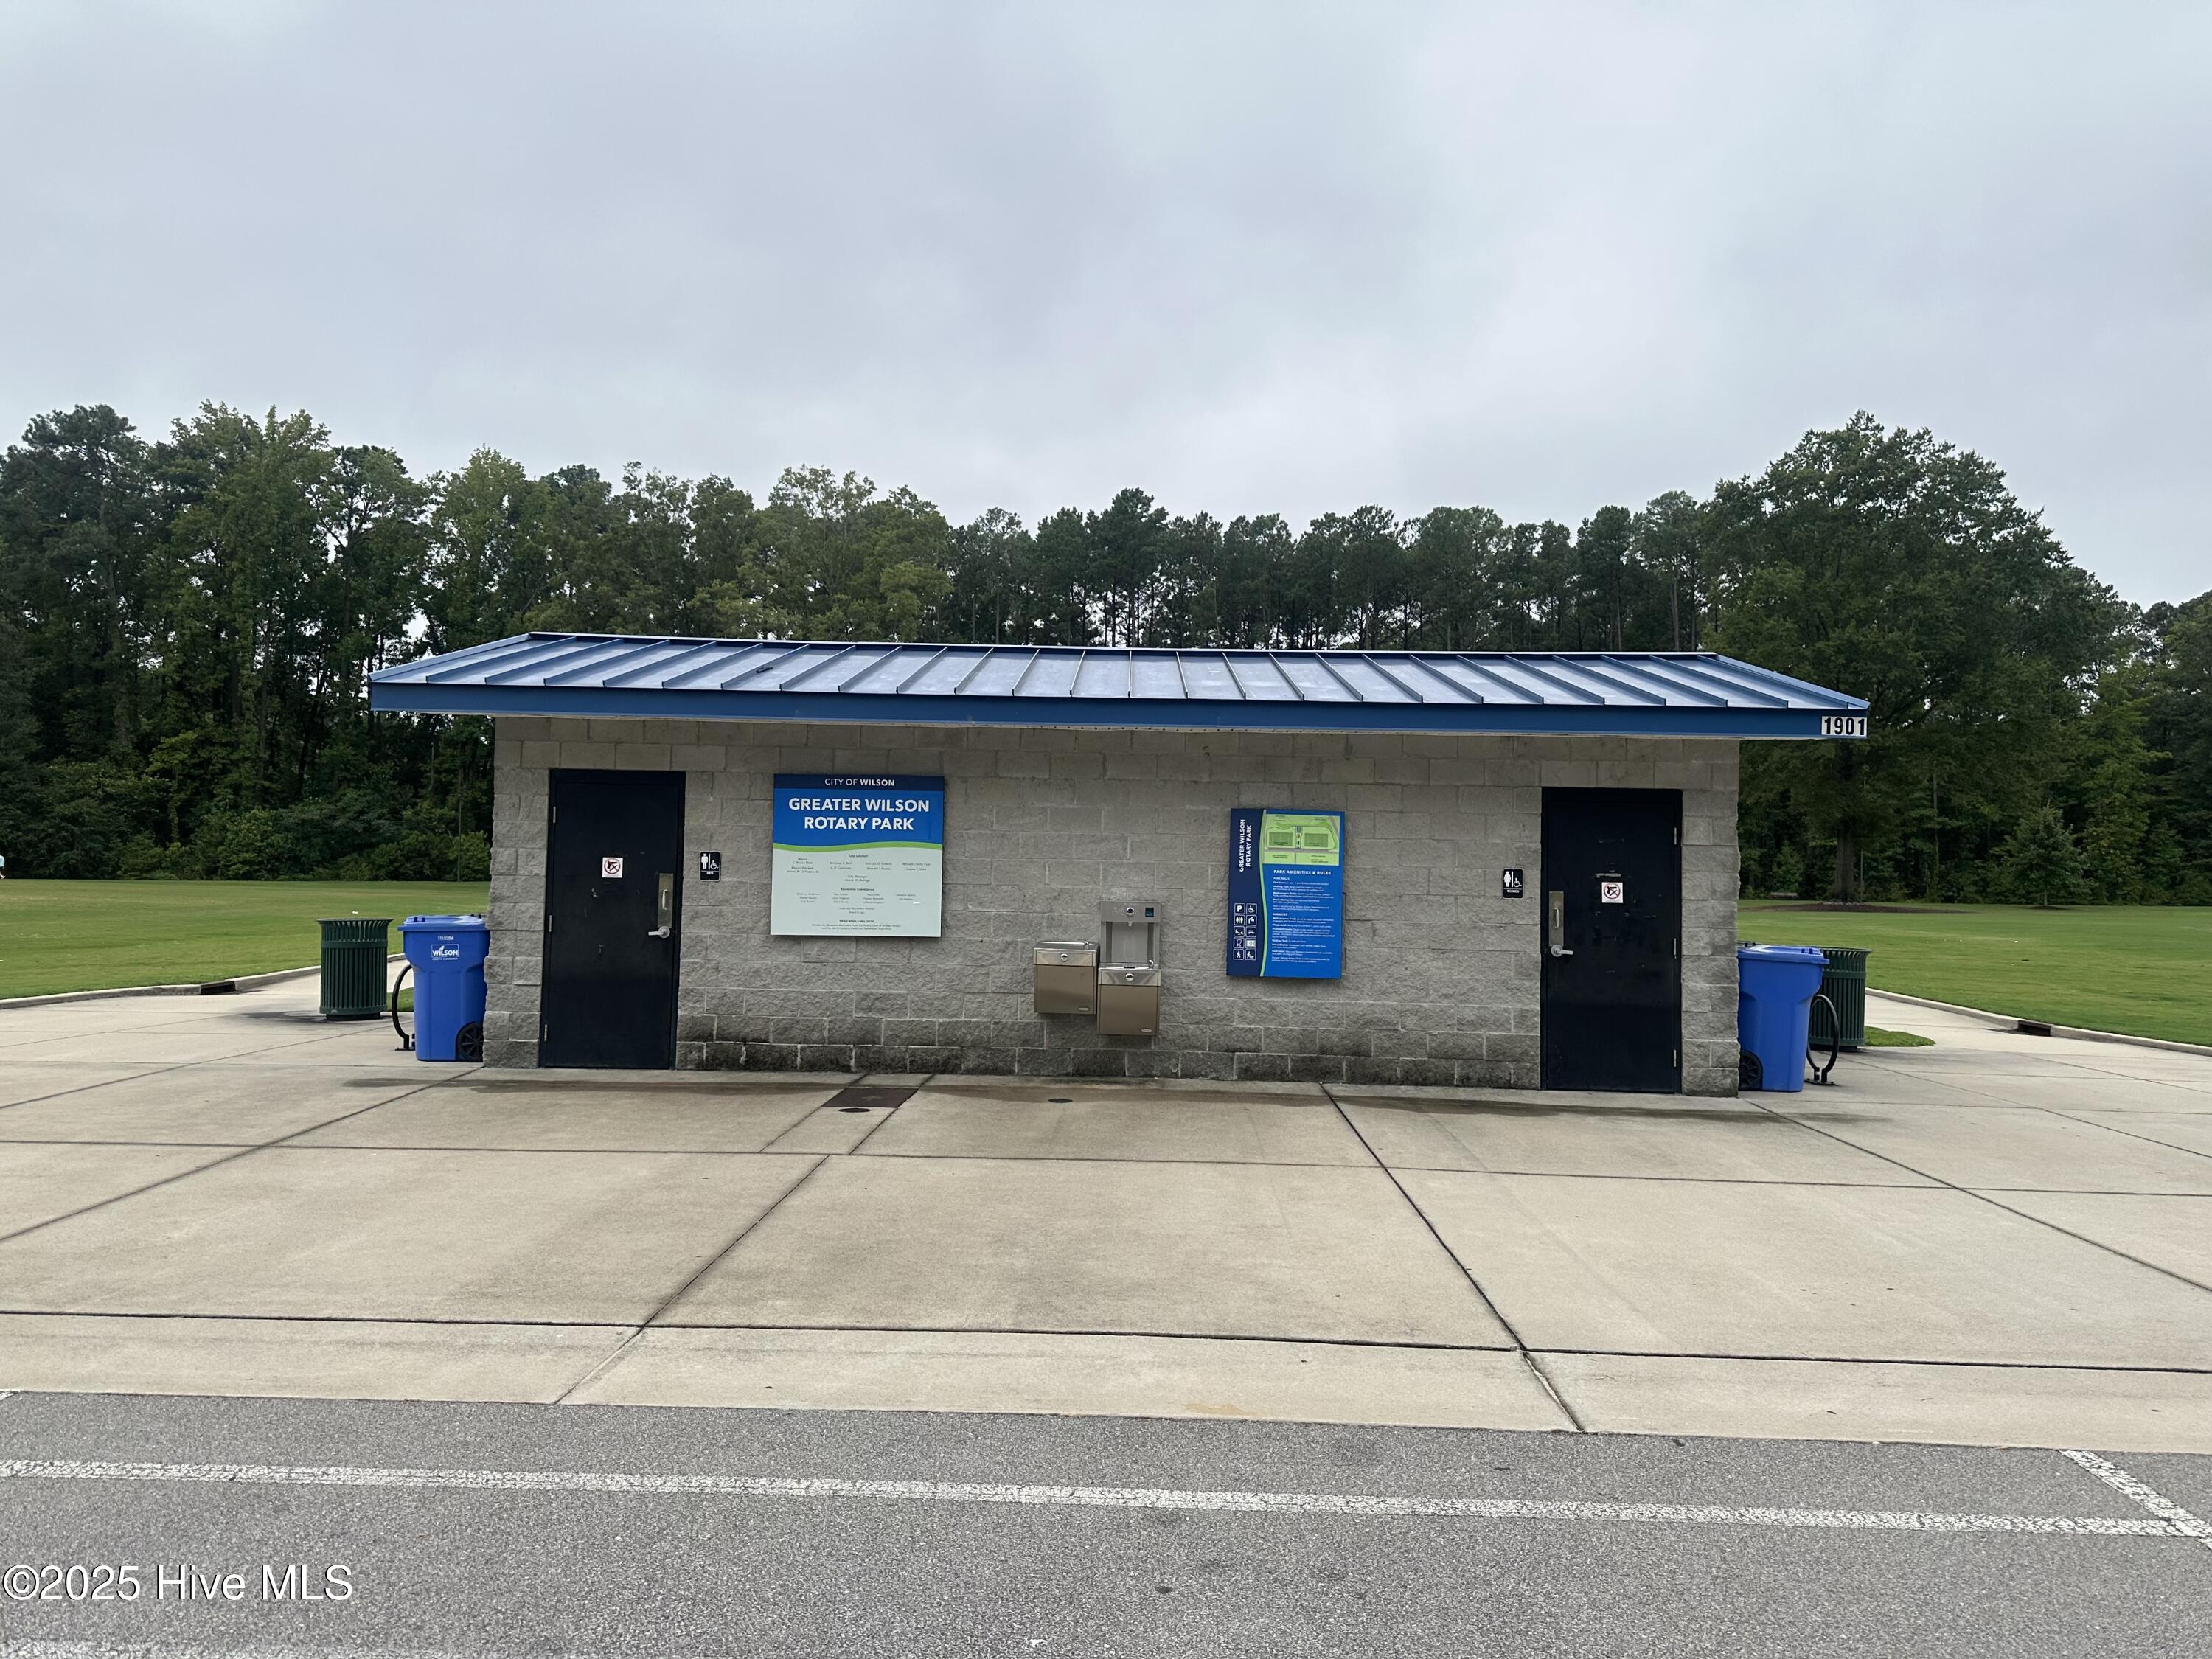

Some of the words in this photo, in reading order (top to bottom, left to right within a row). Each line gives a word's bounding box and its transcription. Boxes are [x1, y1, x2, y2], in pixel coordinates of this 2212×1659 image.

[1824, 717, 1865, 735] 1901
[788, 798, 861, 811] GREATER
[864, 799, 929, 812] WILSON
[804, 816, 869, 830] ROTARY
[872, 818, 914, 830] PARK
